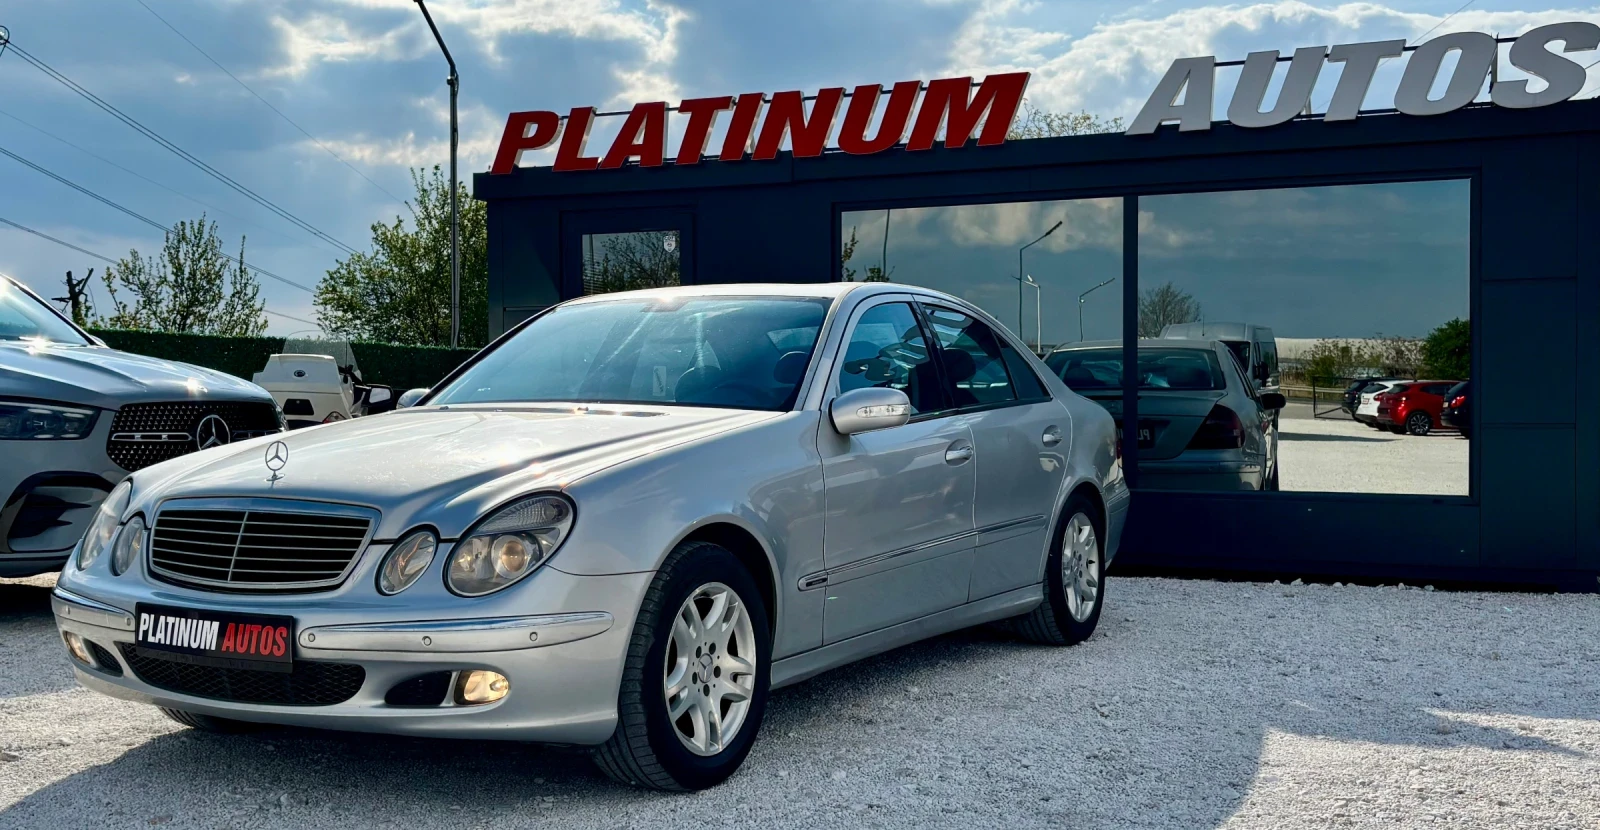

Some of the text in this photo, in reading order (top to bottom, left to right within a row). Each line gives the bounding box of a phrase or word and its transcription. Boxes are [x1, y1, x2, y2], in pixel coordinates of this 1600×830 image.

[490, 21, 1600, 175] PLATINUM AUTOS
[138, 612, 288, 657] PLATINUM AUTOS
